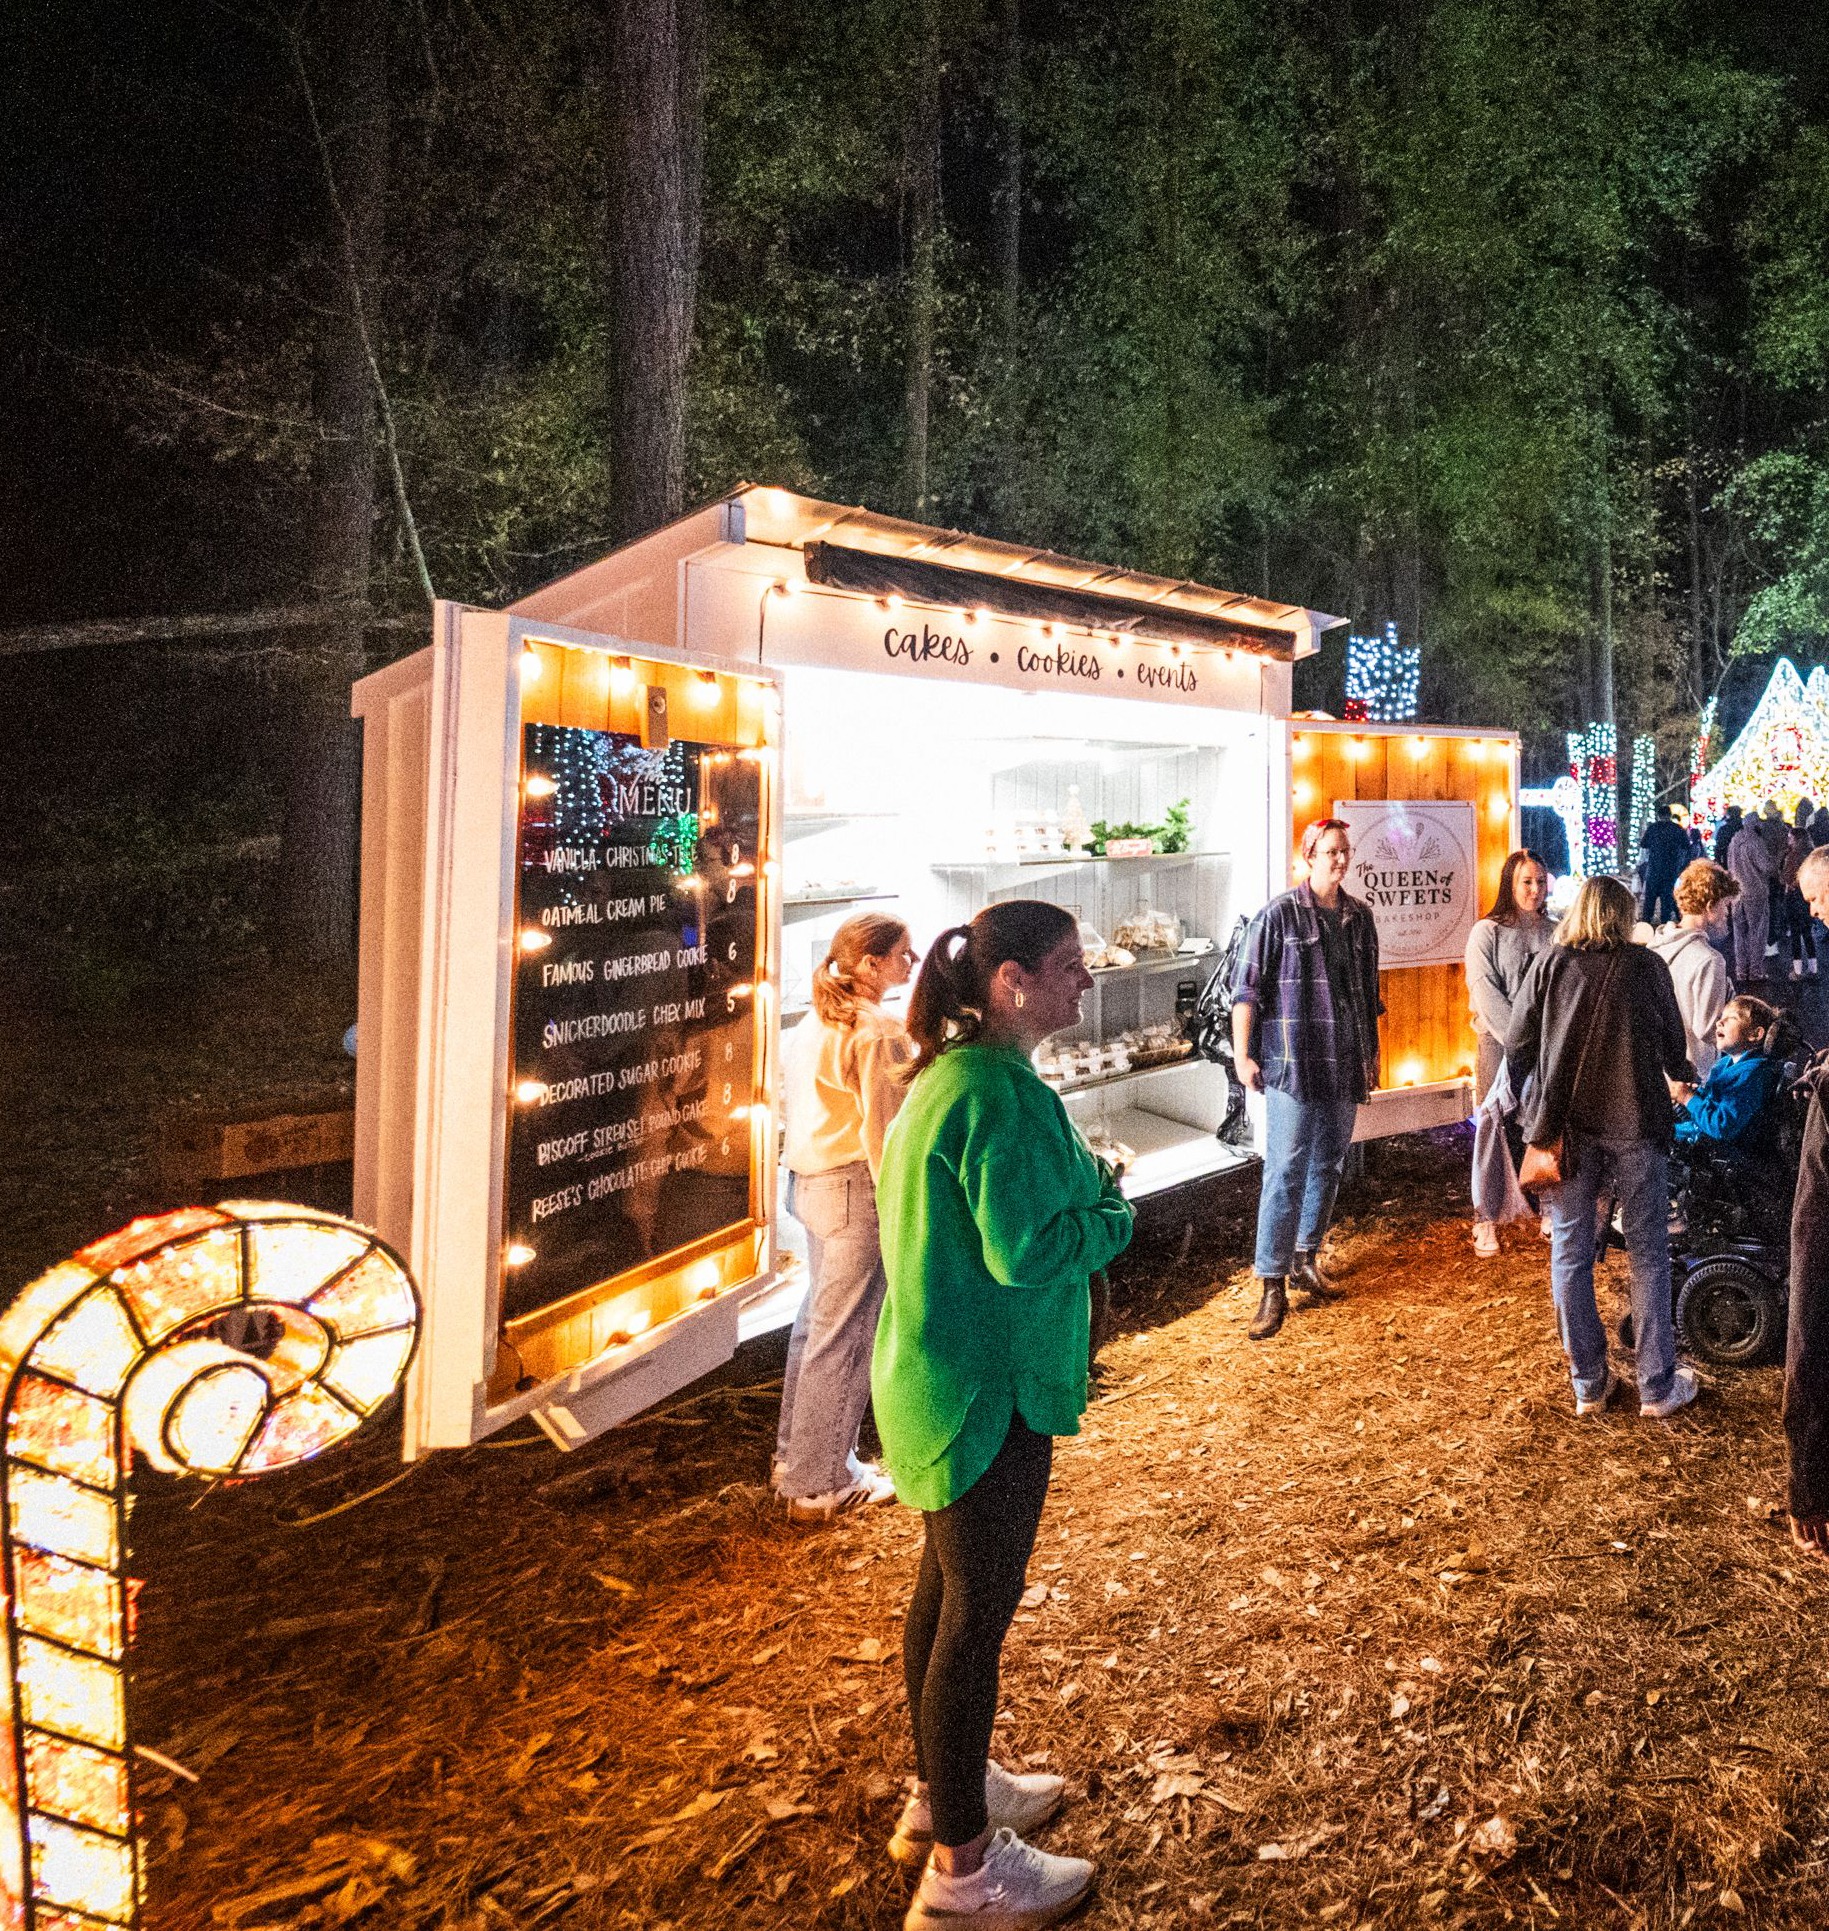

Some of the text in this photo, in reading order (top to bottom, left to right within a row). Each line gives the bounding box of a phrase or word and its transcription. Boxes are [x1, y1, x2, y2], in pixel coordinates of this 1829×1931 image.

[1137, 661, 1200, 692] events
[619, 784, 692, 817] MENU
[545, 843, 740, 873] VANILLA CHRISTMAS TE 8
[1356, 861, 1455, 892] The QUEEN of
[542, 878, 737, 928] OATMEAL CREAM PIE 8
[1365, 888, 1452, 908] SWEETS
[1375, 911, 1440, 924] BAKESHOP
[543, 942, 737, 987] FAMOUS GINGERBREAD COOKIE 6
[542, 993, 736, 1049] SNICKERDOODLE CHEX MIX 5
[540, 1042, 734, 1107] DECORATED SUGAR COOKIE 8
[537, 1131, 589, 1167] BISCOFF
[682, 1099, 708, 1122] CAKE
[723, 1083, 732, 1106] 8
[532, 1183, 585, 1223] REESE'S
[588, 1161, 647, 1200] CHOCOLATE
[722, 1137, 731, 1156] 6
